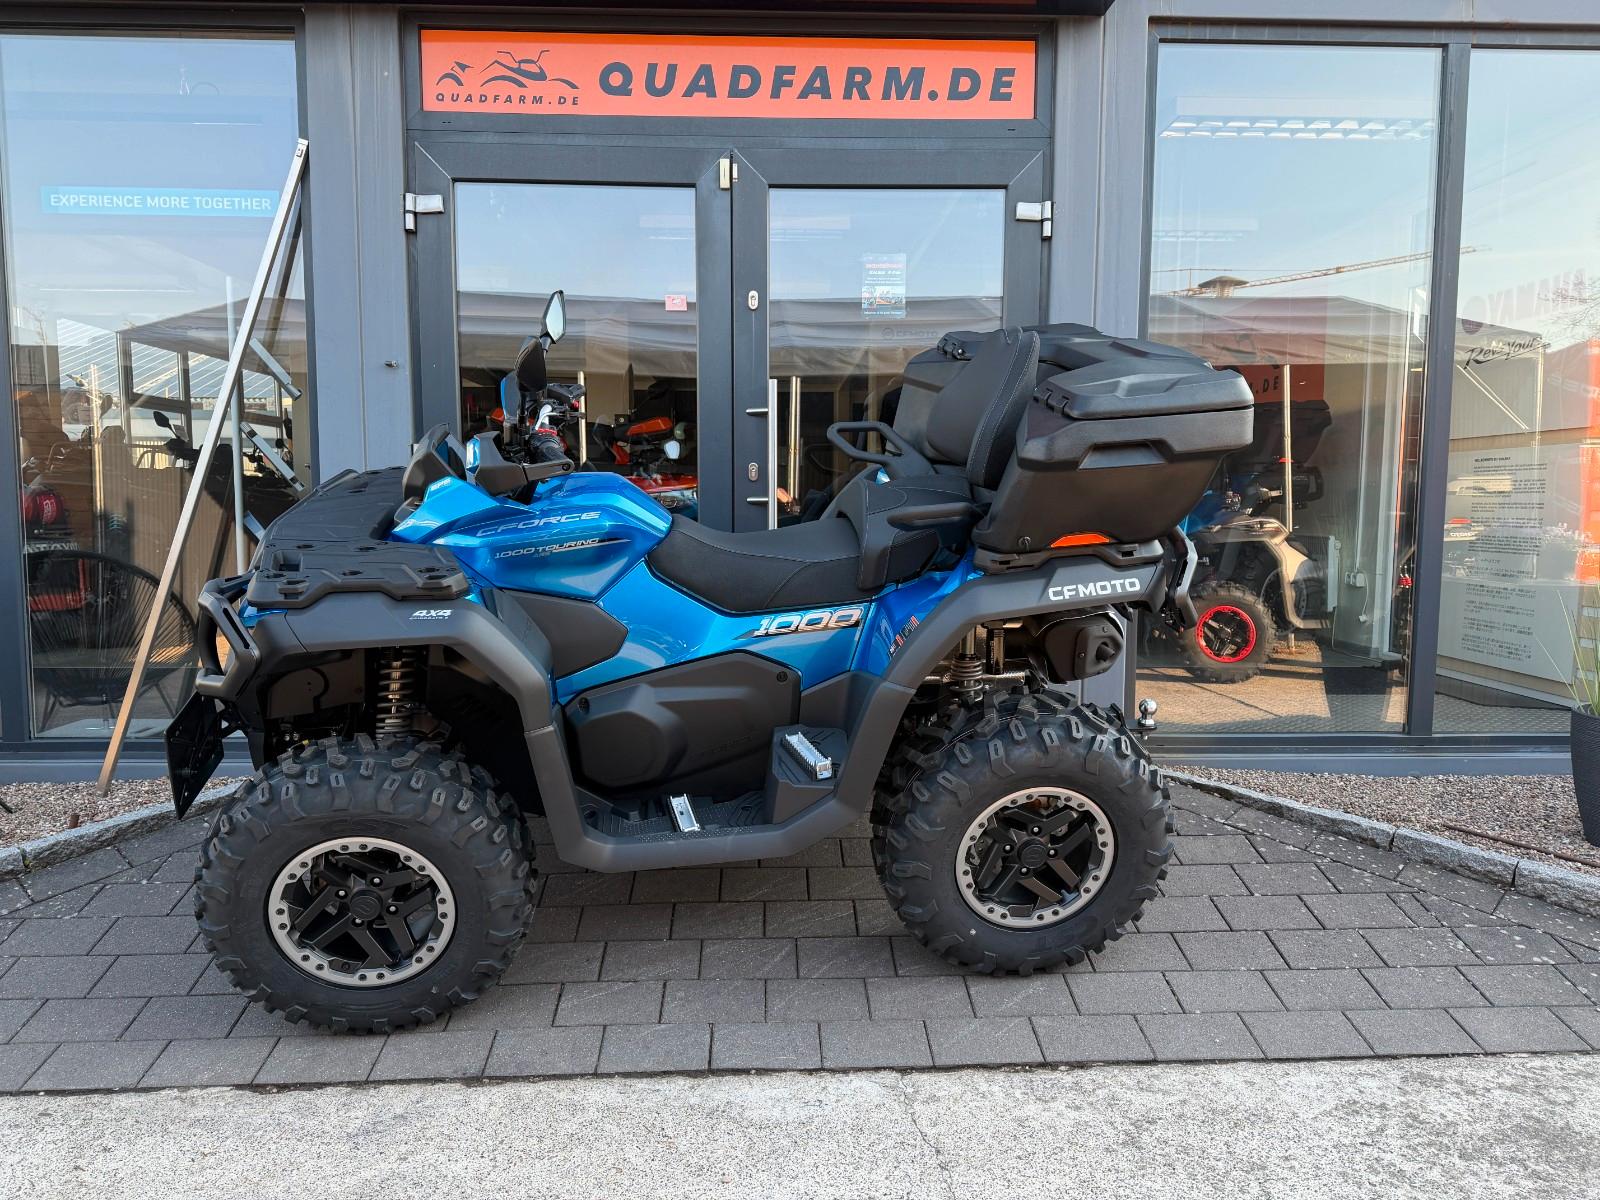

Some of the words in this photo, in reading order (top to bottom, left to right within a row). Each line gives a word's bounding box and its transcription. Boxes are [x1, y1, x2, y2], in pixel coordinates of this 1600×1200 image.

[599, 61, 1017, 102] QUADFARM.DE
[435, 91, 580, 106] QUADFARM.DE
[49, 193, 143, 208] EXPERIENCE
[146, 195, 191, 208] MORE
[193, 196, 273, 211] TOGETHER
[476, 511, 602, 538] CFORCE
[495, 546, 535, 560] 1000
[535, 537, 601, 553] TOURING
[1048, 577, 1141, 601] CFMOTO
[752, 606, 864, 638] 1000
